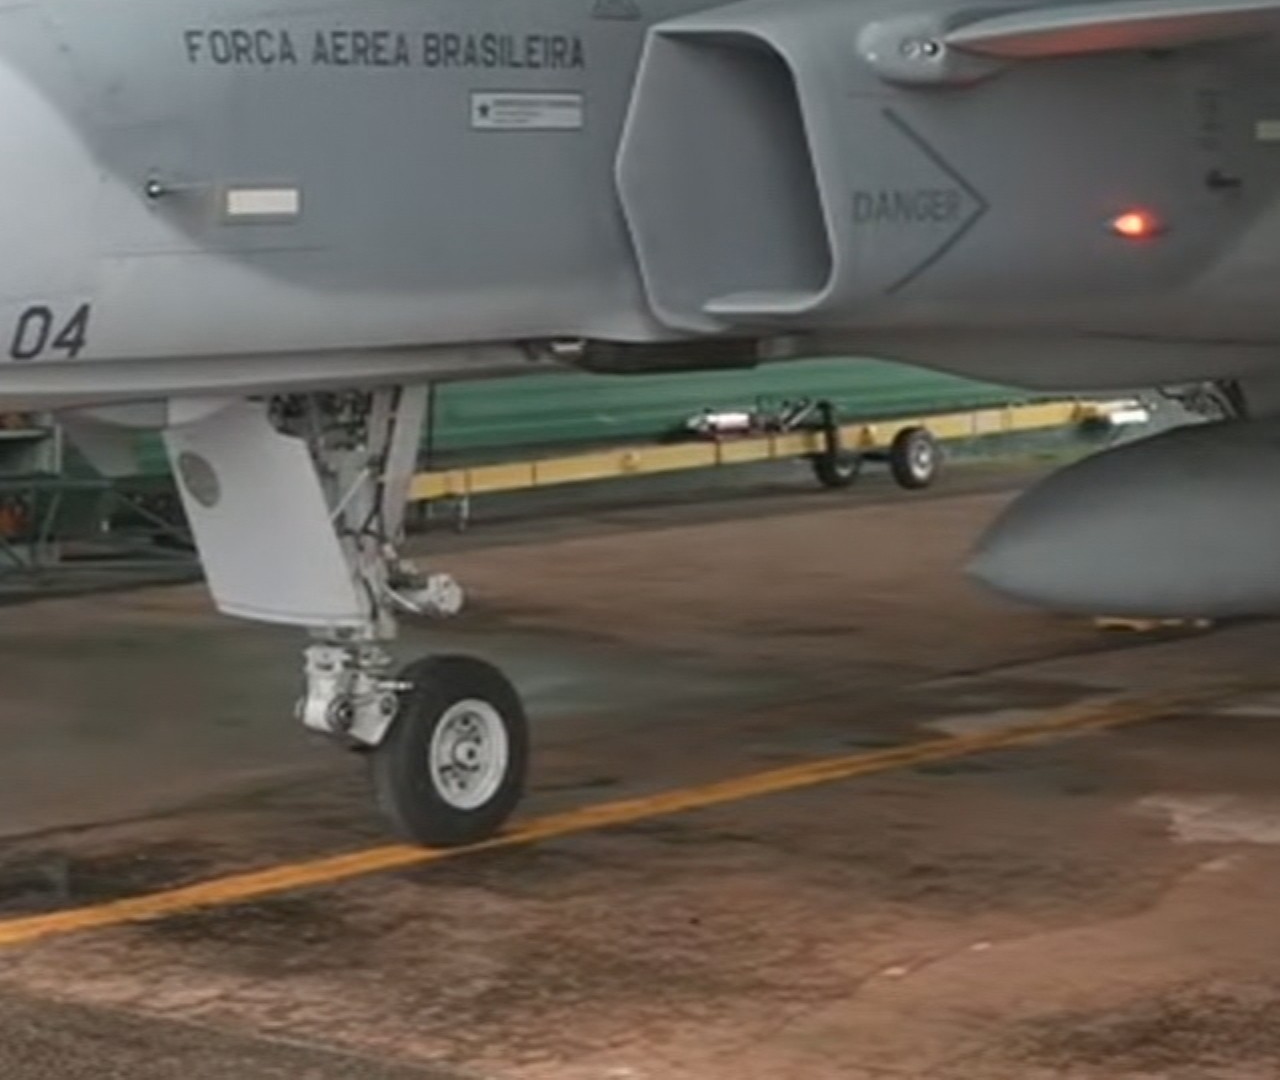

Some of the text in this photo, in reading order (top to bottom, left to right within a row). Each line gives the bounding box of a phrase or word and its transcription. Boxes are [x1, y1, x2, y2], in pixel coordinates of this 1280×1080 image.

[423, 31, 586, 71] BRASILEIRA
[851, 189, 960, 225] DANGER
[10, 302, 91, 361] 04
